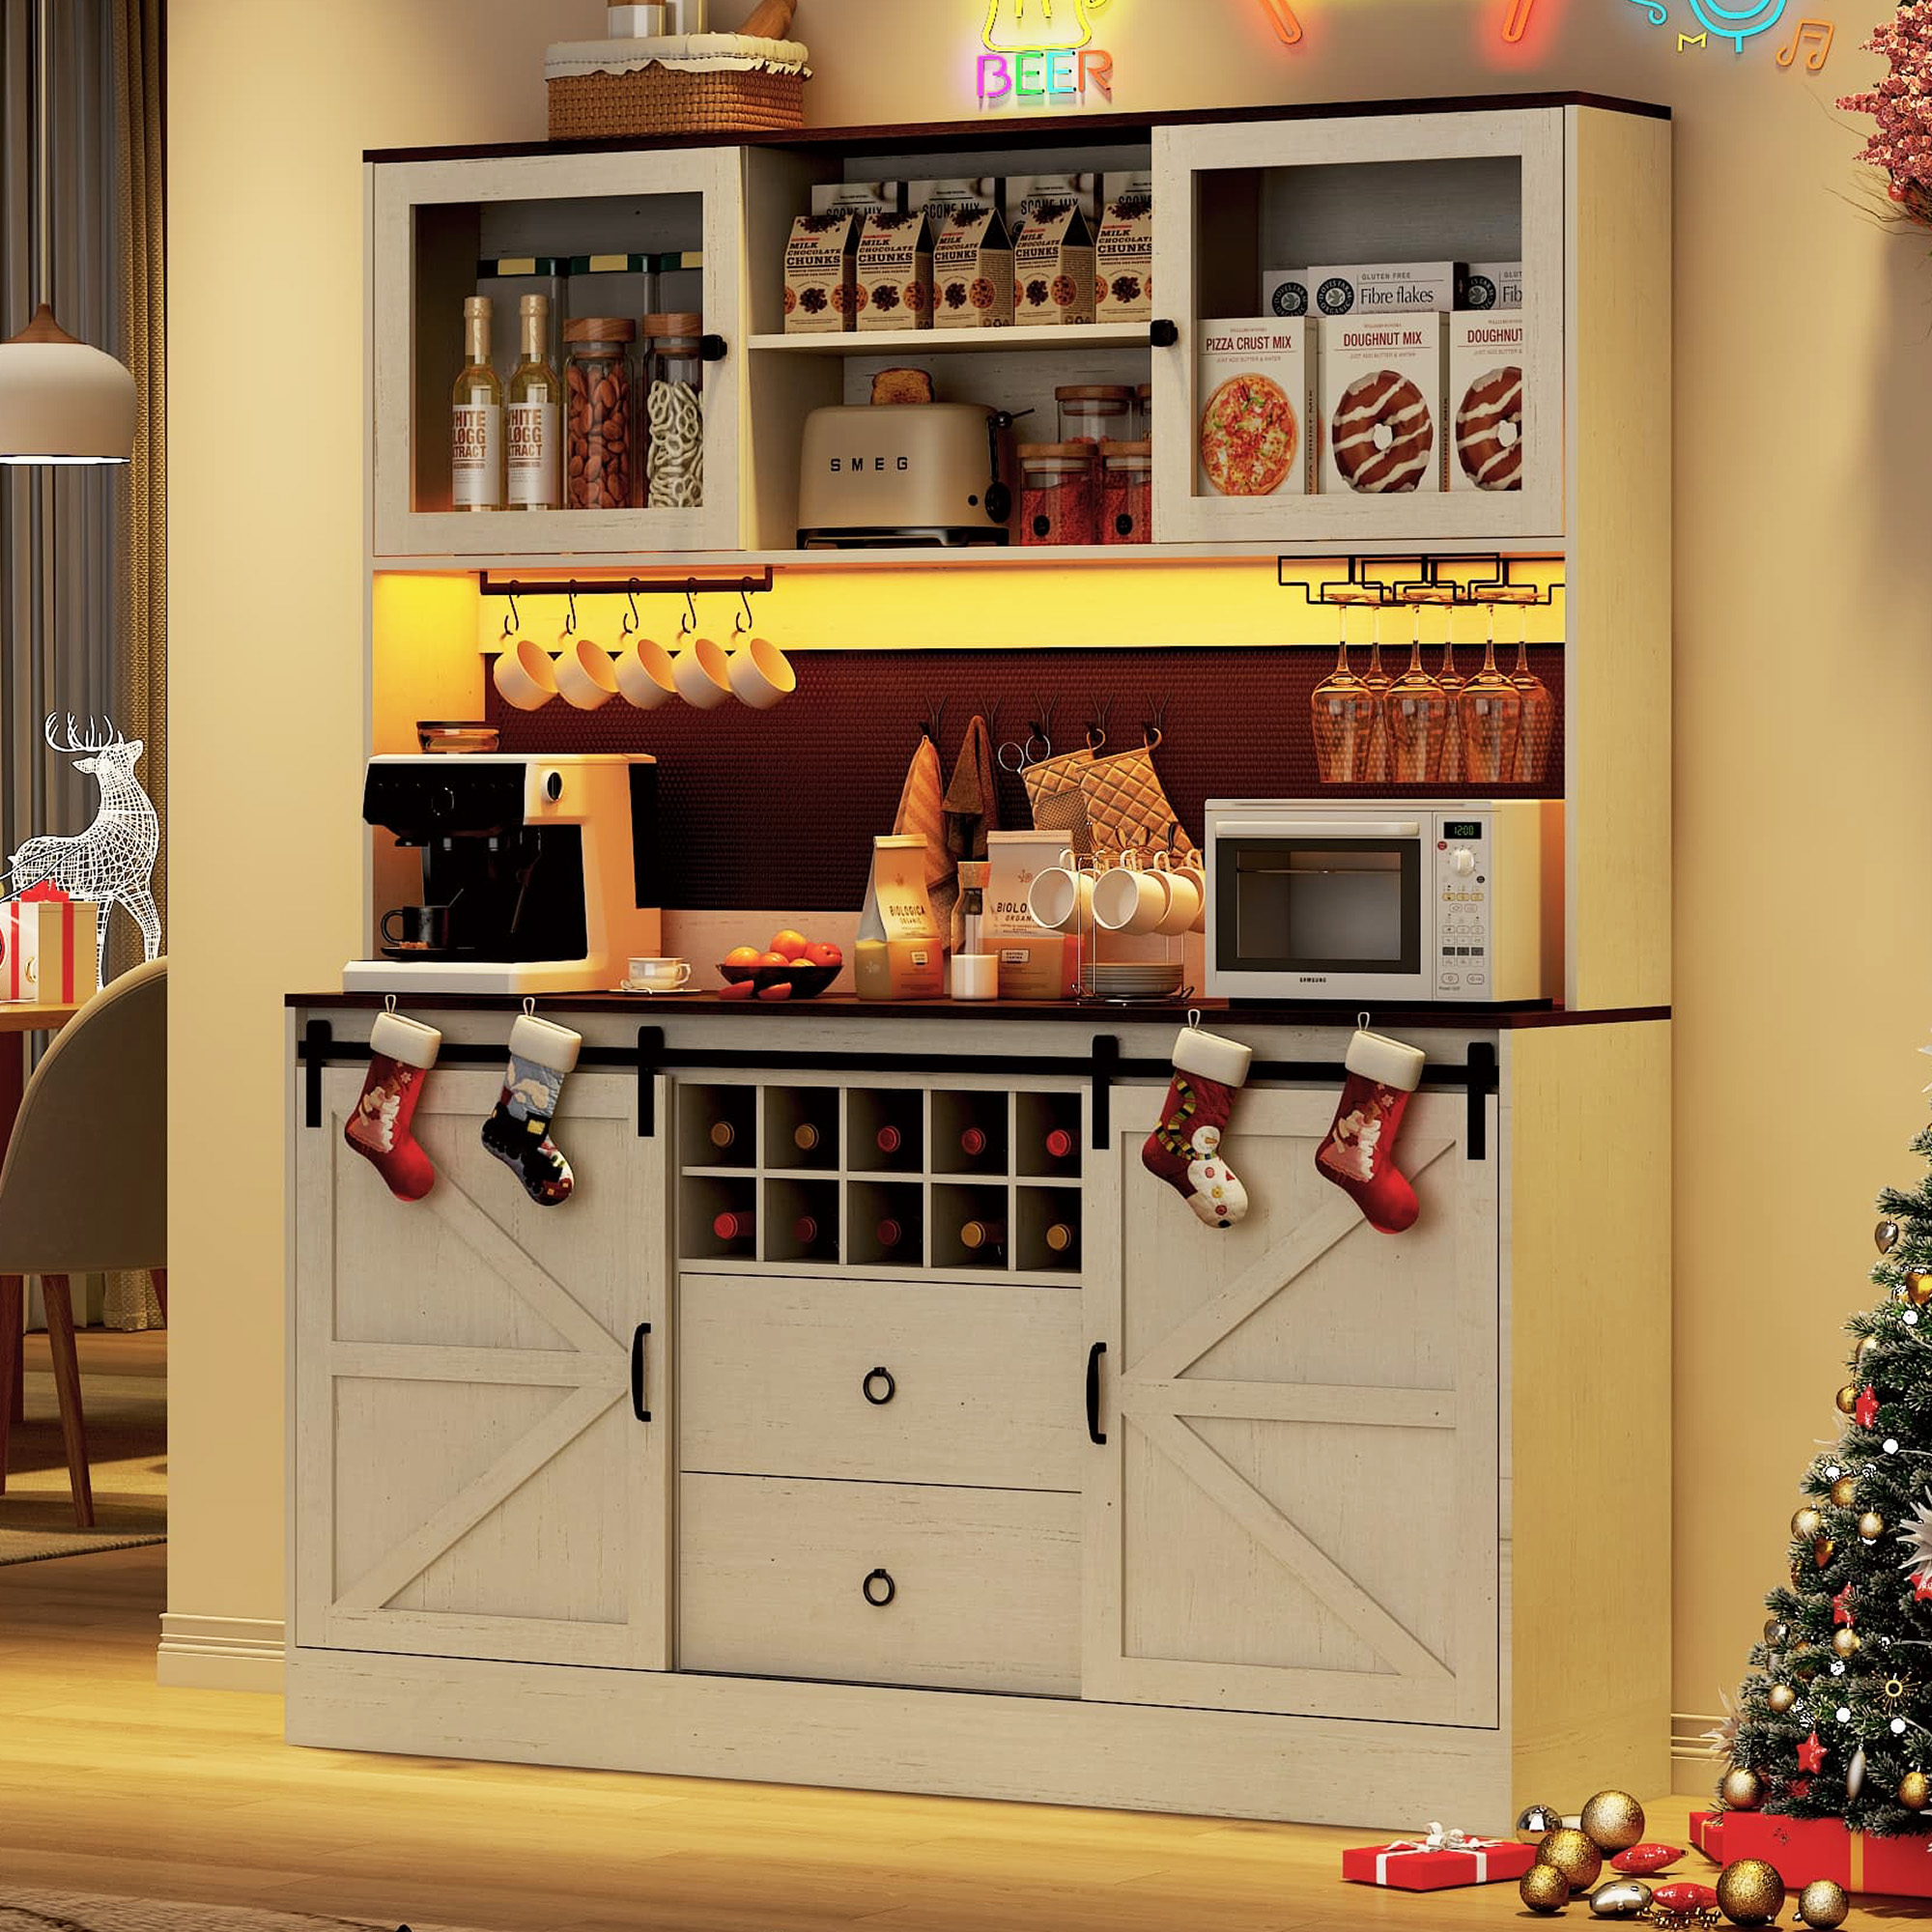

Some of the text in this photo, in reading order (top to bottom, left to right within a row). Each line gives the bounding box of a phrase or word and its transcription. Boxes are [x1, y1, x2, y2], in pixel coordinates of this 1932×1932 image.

[977, 49, 1114, 98] BEER
[934, 249, 977, 260] CHUNKS
[1015, 246, 1059, 257] CHUNKS
[1097, 243, 1151, 253] CHUNKS
[786, 256, 840, 265] CHUNKS
[859, 253, 913, 262] CHUNKS
[1361, 285, 1435, 304] Fibre flakes
[1503, 284, 1522, 302] Fib
[1207, 335, 1292, 351] PIZZA CRUST MIX
[1344, 331, 1422, 347] DOUGHNUT MIX
[455, 411, 486, 427] HITE
[454, 445, 487, 458] TRACT
[830, 456, 909, 471] SMEG
[1454, 825, 1475, 836] 12:00
[997, 902, 1028, 913] BIOLO
